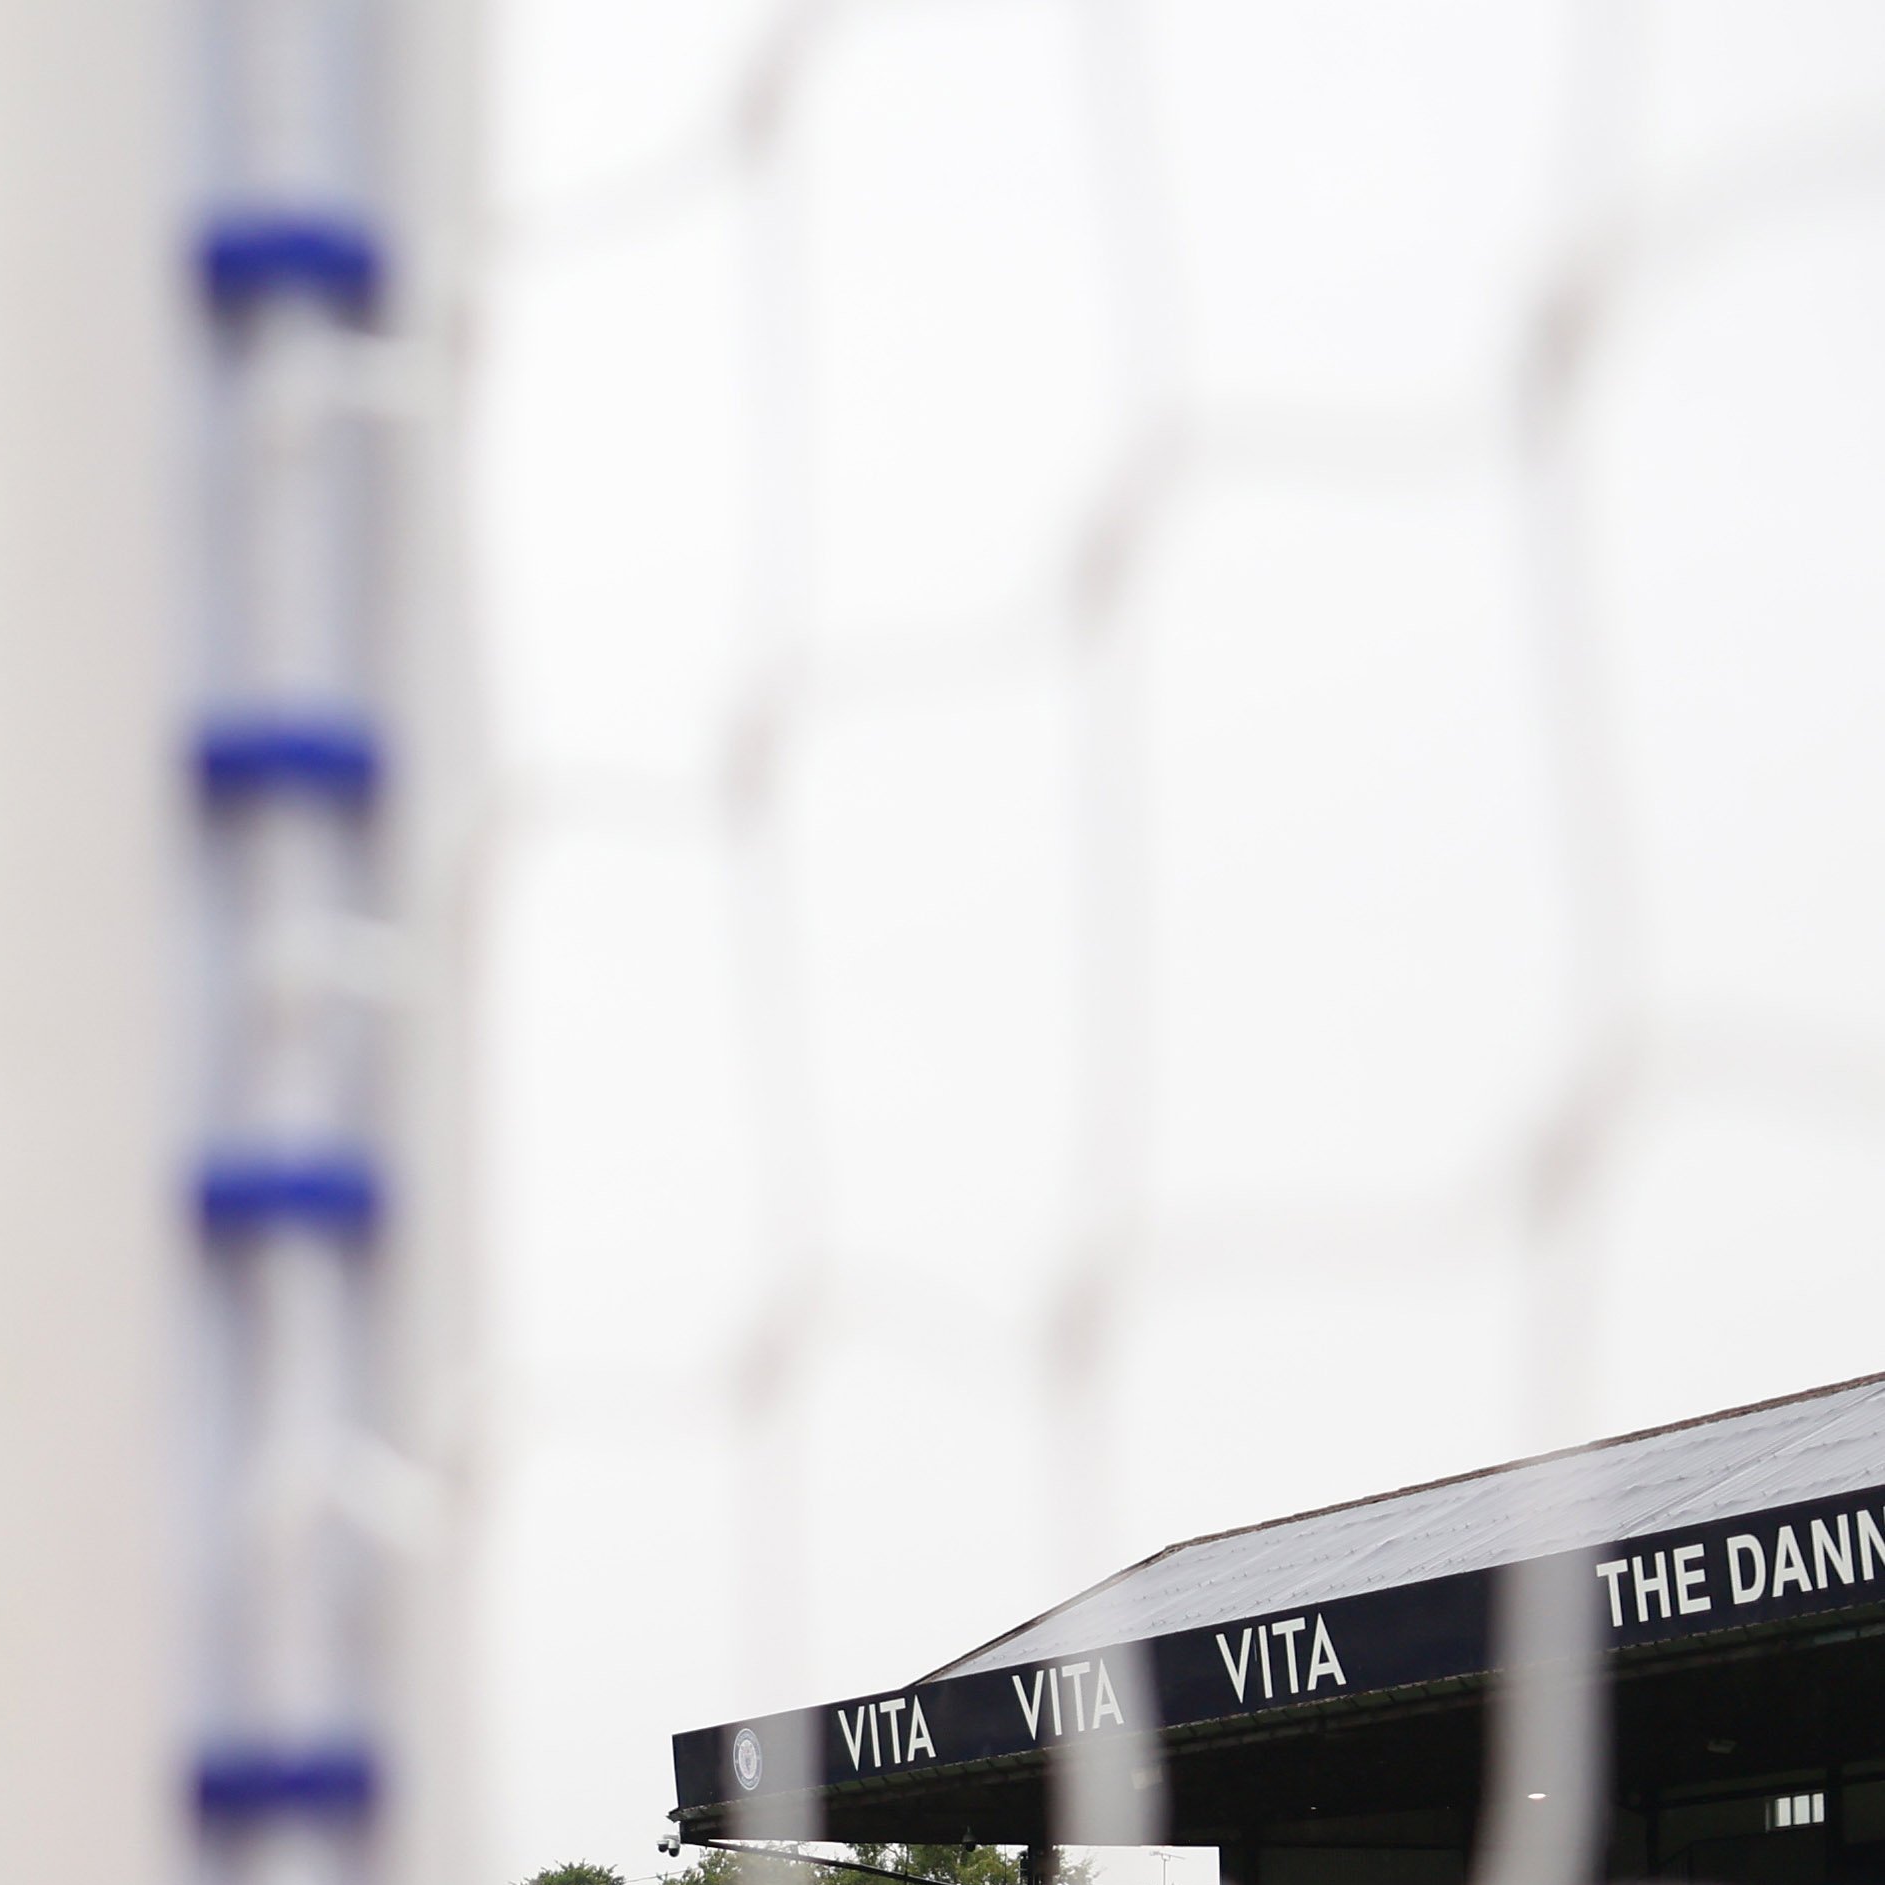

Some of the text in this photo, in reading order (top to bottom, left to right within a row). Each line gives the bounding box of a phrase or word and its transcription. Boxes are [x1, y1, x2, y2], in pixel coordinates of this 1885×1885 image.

[1596, 1543, 1711, 1627] THE
[1012, 1658, 1124, 1740] VITA
[1215, 1612, 1346, 1703] VITA
[838, 1693, 936, 1771] VITA
